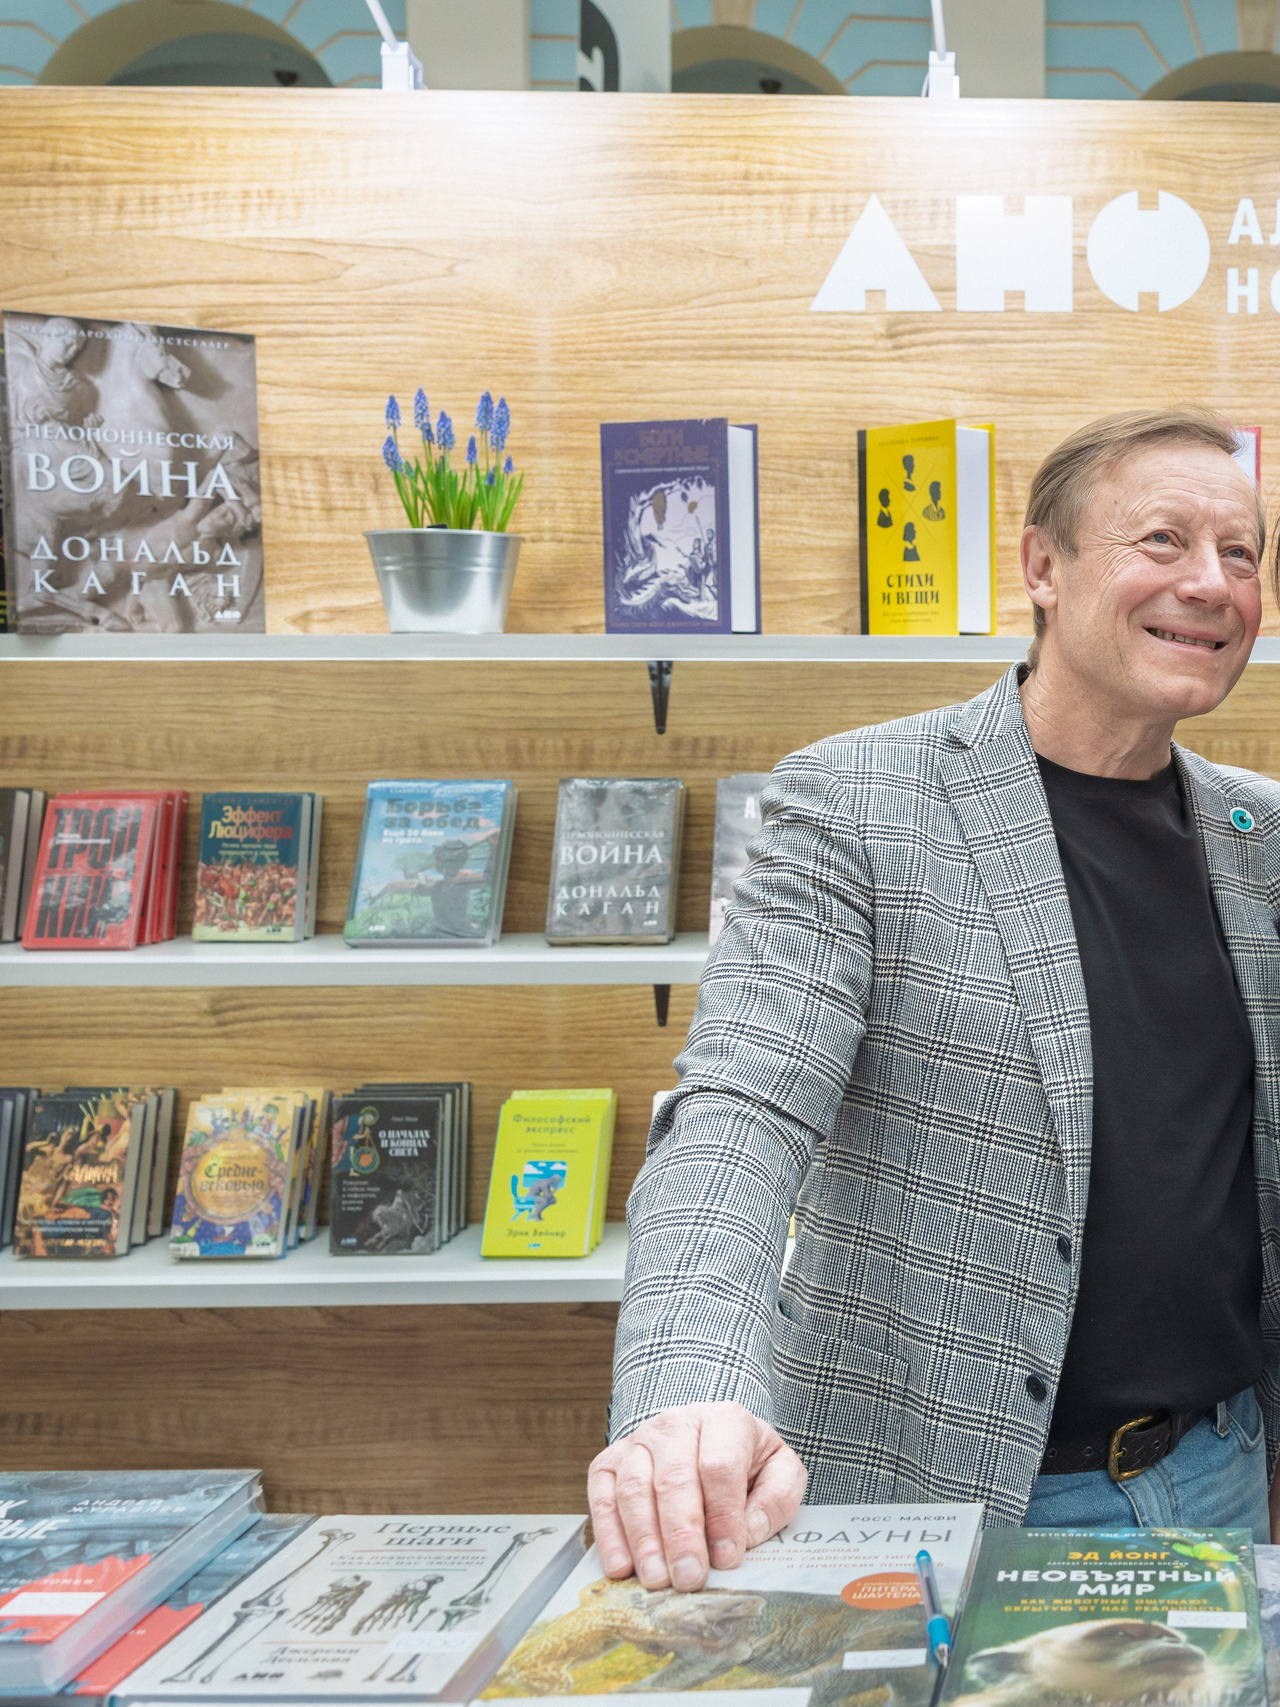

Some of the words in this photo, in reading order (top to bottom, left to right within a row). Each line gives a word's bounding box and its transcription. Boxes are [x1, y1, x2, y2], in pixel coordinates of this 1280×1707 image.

[24, 422, 235, 451] ПЕЛОПОННЕССКАЯ
[24, 448, 240, 500] ВОЙНА
[30, 535, 242, 567] ДОНАЛЬД
[32, 568, 242, 598] КАГАН
[886, 573, 935, 588] СТИХИ
[882, 592, 892, 605] И
[896, 590, 940, 606] ВЕЩИ
[385, 798, 483, 816] Борьба
[221, 805, 284, 827] Эффект
[383, 817, 411, 829] за
[421, 814, 480, 831] обед
[208, 820, 294, 843] Люцифера
[560, 841, 664, 866] ВОЙНА
[556, 885, 661, 899] ДОНАЛЬД
[556, 902, 659, 916] КАГАН
[513, 1113, 591, 1126] Философский
[378, 1130, 387, 1139] О
[387, 1129, 431, 1139] НАЧАЛАХ
[525, 1126, 576, 1135] экспресс
[380, 1139, 388, 1148] И
[389, 1139, 428, 1148] КОНЦАХ
[388, 1148, 419, 1157] СВЕТА
[373, 1522, 512, 1537] Первые
[382, 1537, 478, 1546] шаги
[1067, 1551, 1100, 1561] ЭД
[1109, 1550, 1171, 1560] ЙОНГ
[996, 1568, 1235, 1583] НЕОБЪЯТНЫЙ
[861, 1585, 917, 1593] ПИТЕРА
[1076, 1583, 1156, 1596] МИР
